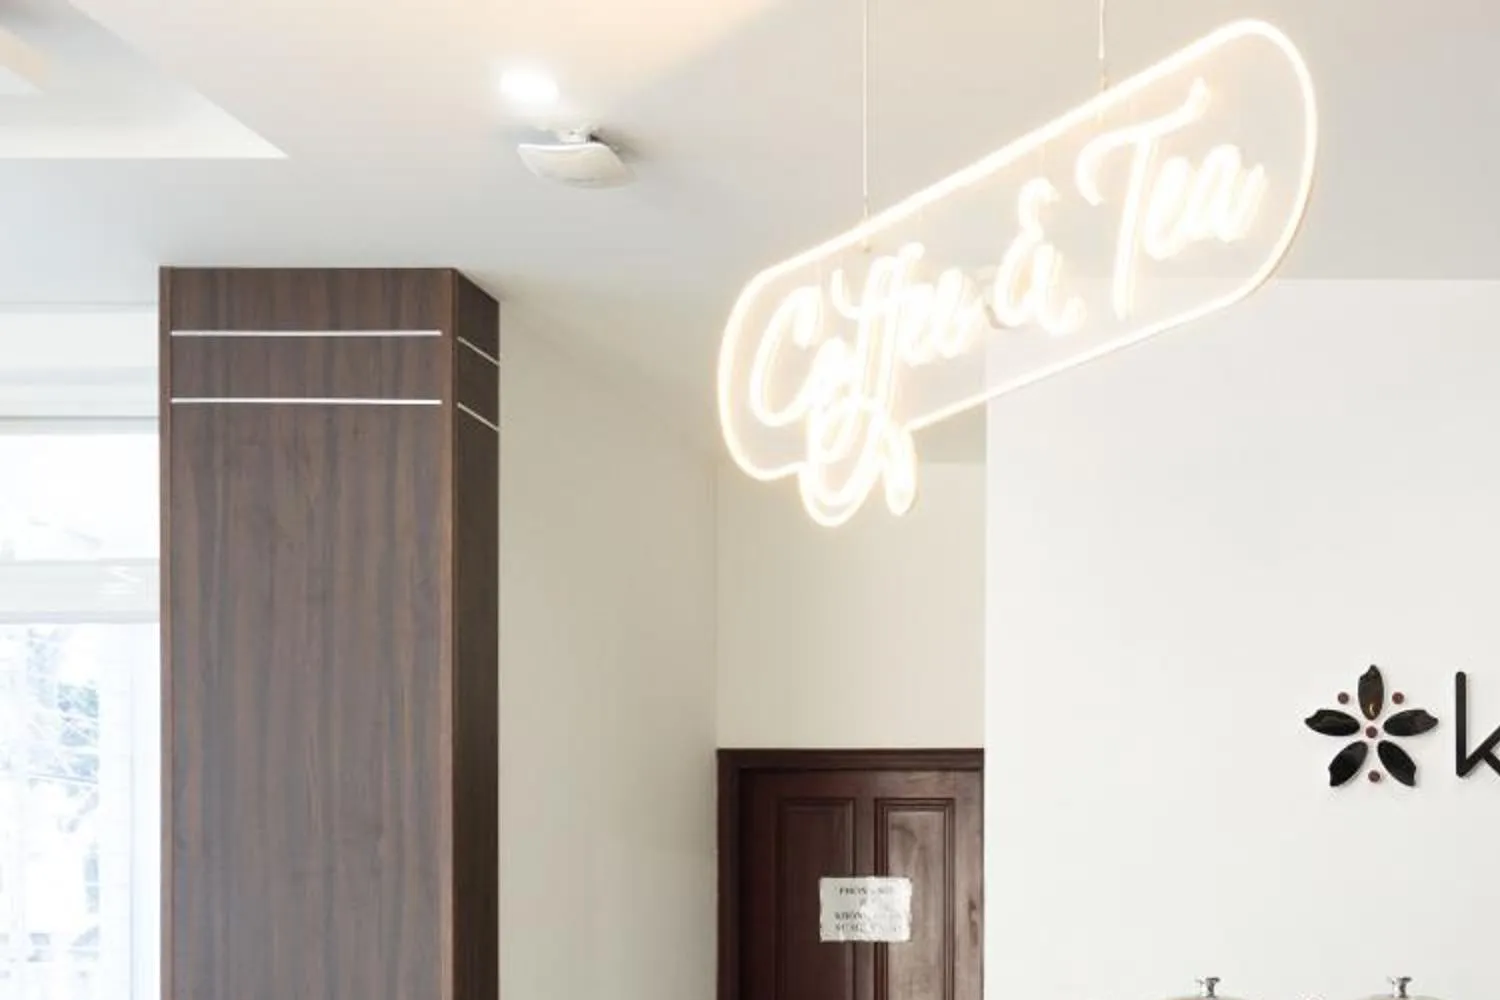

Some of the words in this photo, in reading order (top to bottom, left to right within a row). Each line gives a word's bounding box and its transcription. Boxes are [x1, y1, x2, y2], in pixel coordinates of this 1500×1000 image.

[748, 241, 985, 527] Coffee
[994, 178, 1084, 335] &
[1076, 77, 1269, 321] Tea
